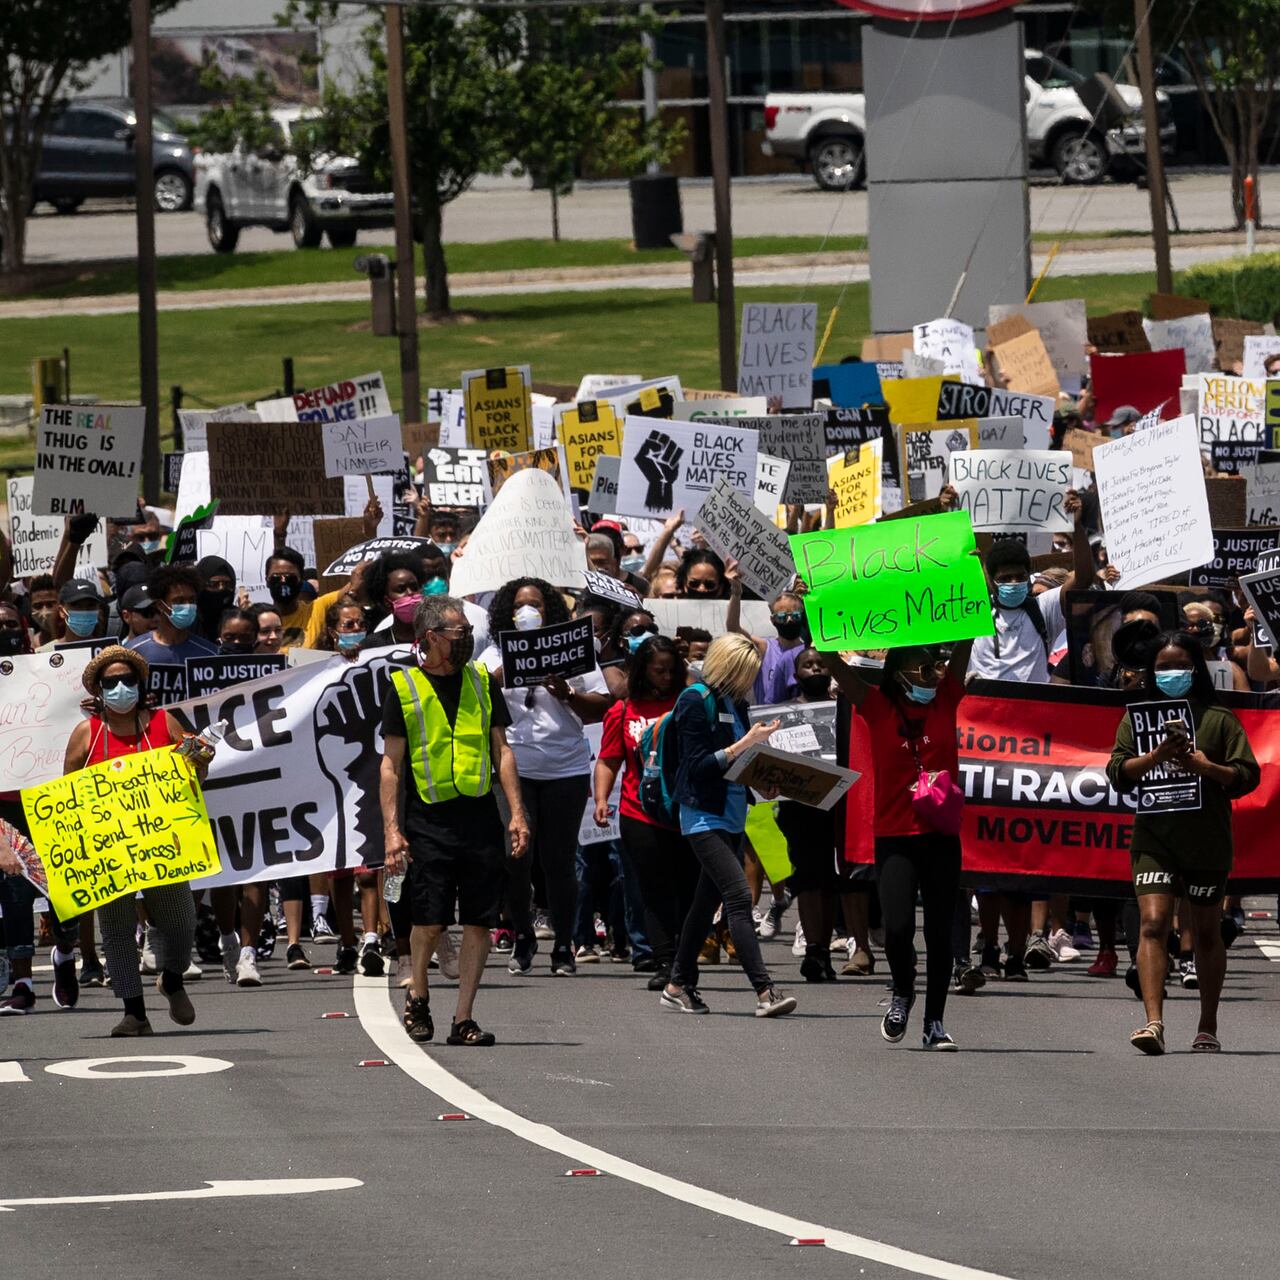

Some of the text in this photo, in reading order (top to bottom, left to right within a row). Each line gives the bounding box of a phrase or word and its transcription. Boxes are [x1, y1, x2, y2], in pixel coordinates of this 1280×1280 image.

[748, 308, 813, 333] BLACK
[742, 342, 806, 368] LIVES
[294, 378, 381, 411] DEFUND THE
[739, 375, 806, 395] MATTER
[298, 403, 356, 422] POLICE
[474, 398, 520, 411] ASIANS
[939, 382, 1046, 421] STRONGER
[45, 409, 112, 430] THE REAL
[487, 410, 511, 422] FOR
[45, 432, 115, 451] THUG IS
[331, 425, 367, 442] SAY
[479, 427, 520, 437] BLACK
[484, 436, 517, 448] LIVES
[694, 433, 744, 452] BLACK
[346, 440, 391, 455] THEIR
[38, 455, 135, 477] IN THE OVAL!
[336, 457, 388, 468] NAMES
[691, 452, 734, 468] LIVES
[953, 457, 1068, 482] BLACK LIVES
[686, 469, 746, 488] MATTER
[51, 499, 84, 513] BLM
[728, 492, 767, 535] teach my
[960, 488, 1067, 524] MATTER
[719, 506, 747, 537] STAND
[699, 504, 783, 589] NOW MY TURN!
[803, 524, 948, 588] Black
[818, 583, 985, 642] Lives Matter
[508, 626, 589, 651] NO JUSTICE
[516, 646, 585, 670] NO PEACE
[219, 664, 280, 679] JUSTICE
[35, 756, 186, 820] God Breathed
[55, 787, 186, 835] And So Will We
[51, 814, 171, 868] God send the
[66, 832, 181, 886] Angelic Forces!
[72, 875, 126, 907] Bind
[125, 865, 153, 885] the
[1136, 872, 1173, 885] FUCK
[1189, 884, 1215, 897] OFF
